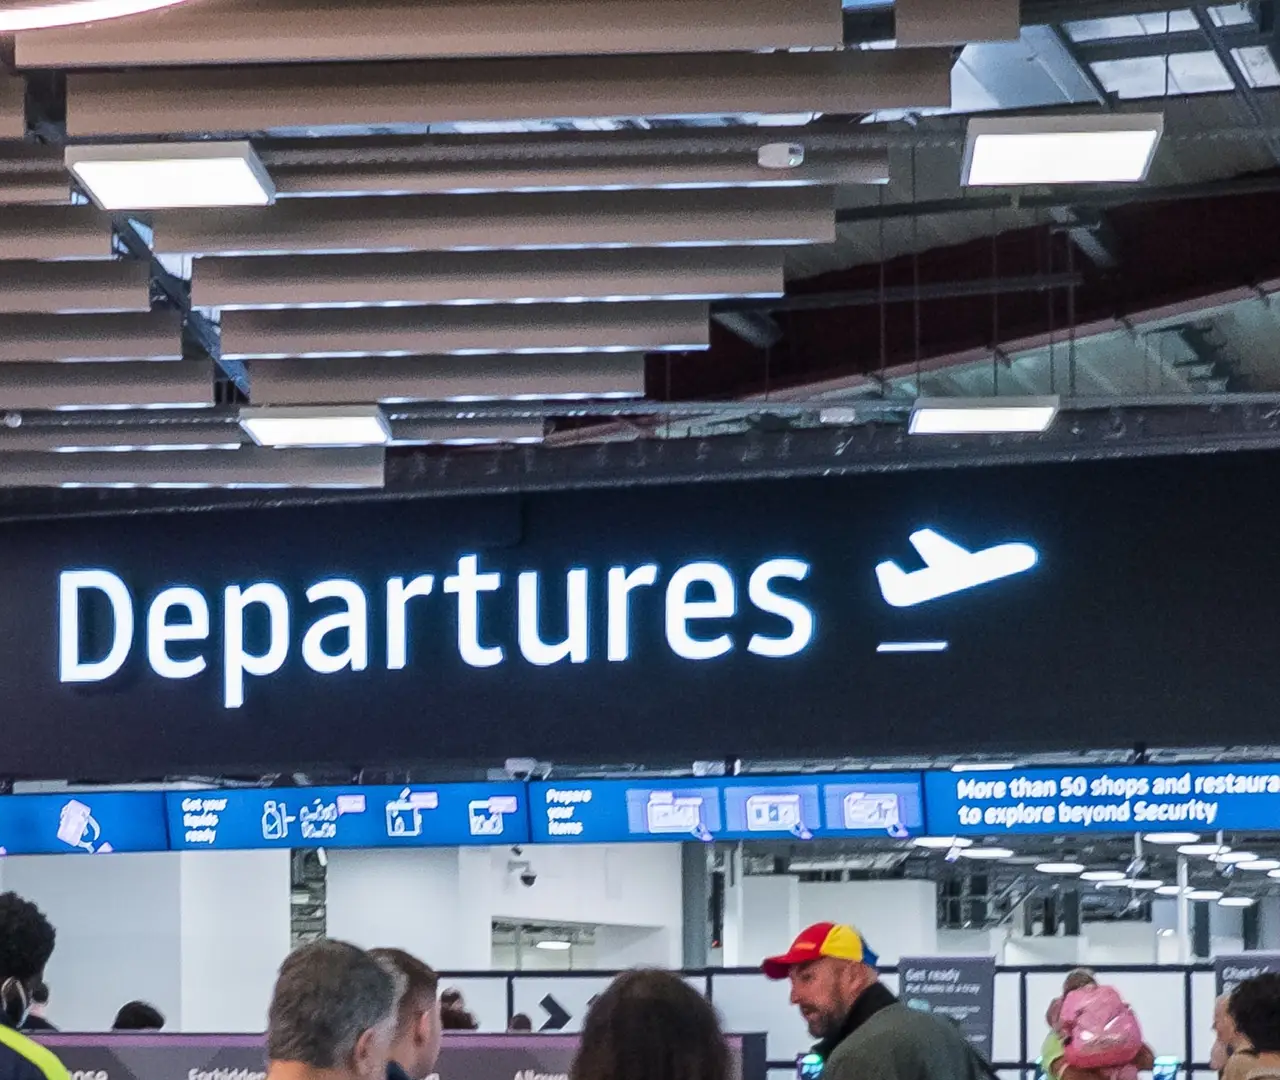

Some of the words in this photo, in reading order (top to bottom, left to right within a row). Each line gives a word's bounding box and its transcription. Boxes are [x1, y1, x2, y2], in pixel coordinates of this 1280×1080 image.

[57, 554, 816, 709] Departures
[546, 788, 592, 806] Prepare
[956, 777, 1007, 800] More
[1009, 777, 1057, 798] than
[1060, 775, 1087, 797] 50
[1090, 775, 1149, 799] shops
[1152, 772, 1190, 796] and
[956, 804, 981, 825] to
[984, 803, 1055, 828] explore
[1058, 800, 1130, 828] beyond
[1133, 798, 1218, 824] Security
